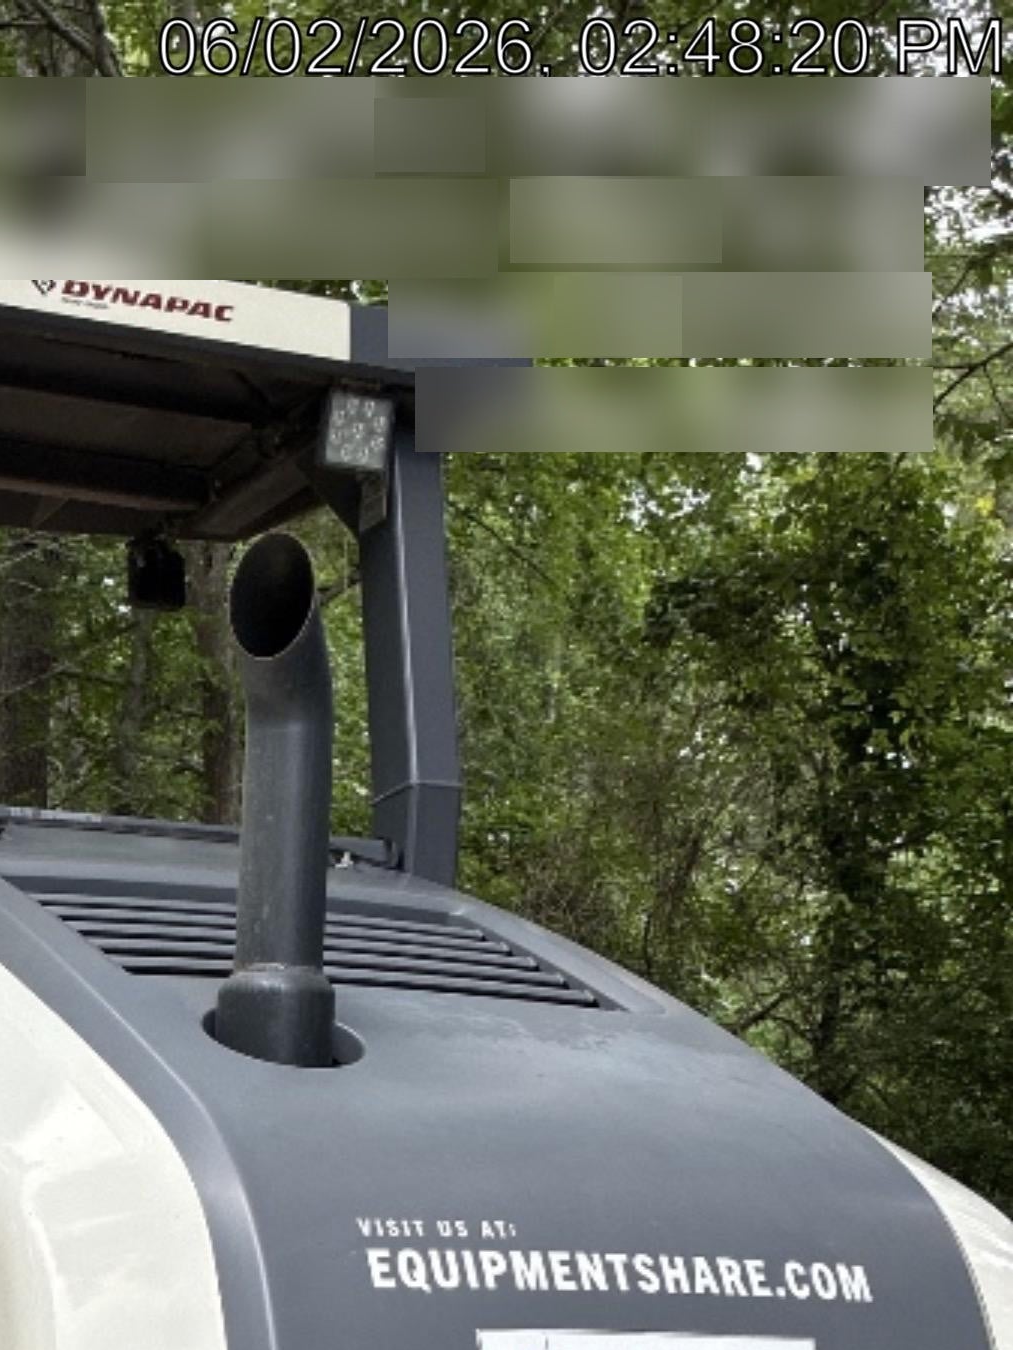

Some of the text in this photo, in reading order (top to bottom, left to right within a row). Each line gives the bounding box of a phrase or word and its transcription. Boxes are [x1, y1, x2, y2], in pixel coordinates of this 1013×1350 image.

[61, 280, 235, 322] DYNAPAC
[356, 1217, 517, 1239] VISIT US AT:
[366, 1247, 874, 1303] EQUIPMENTSHARE.COM
